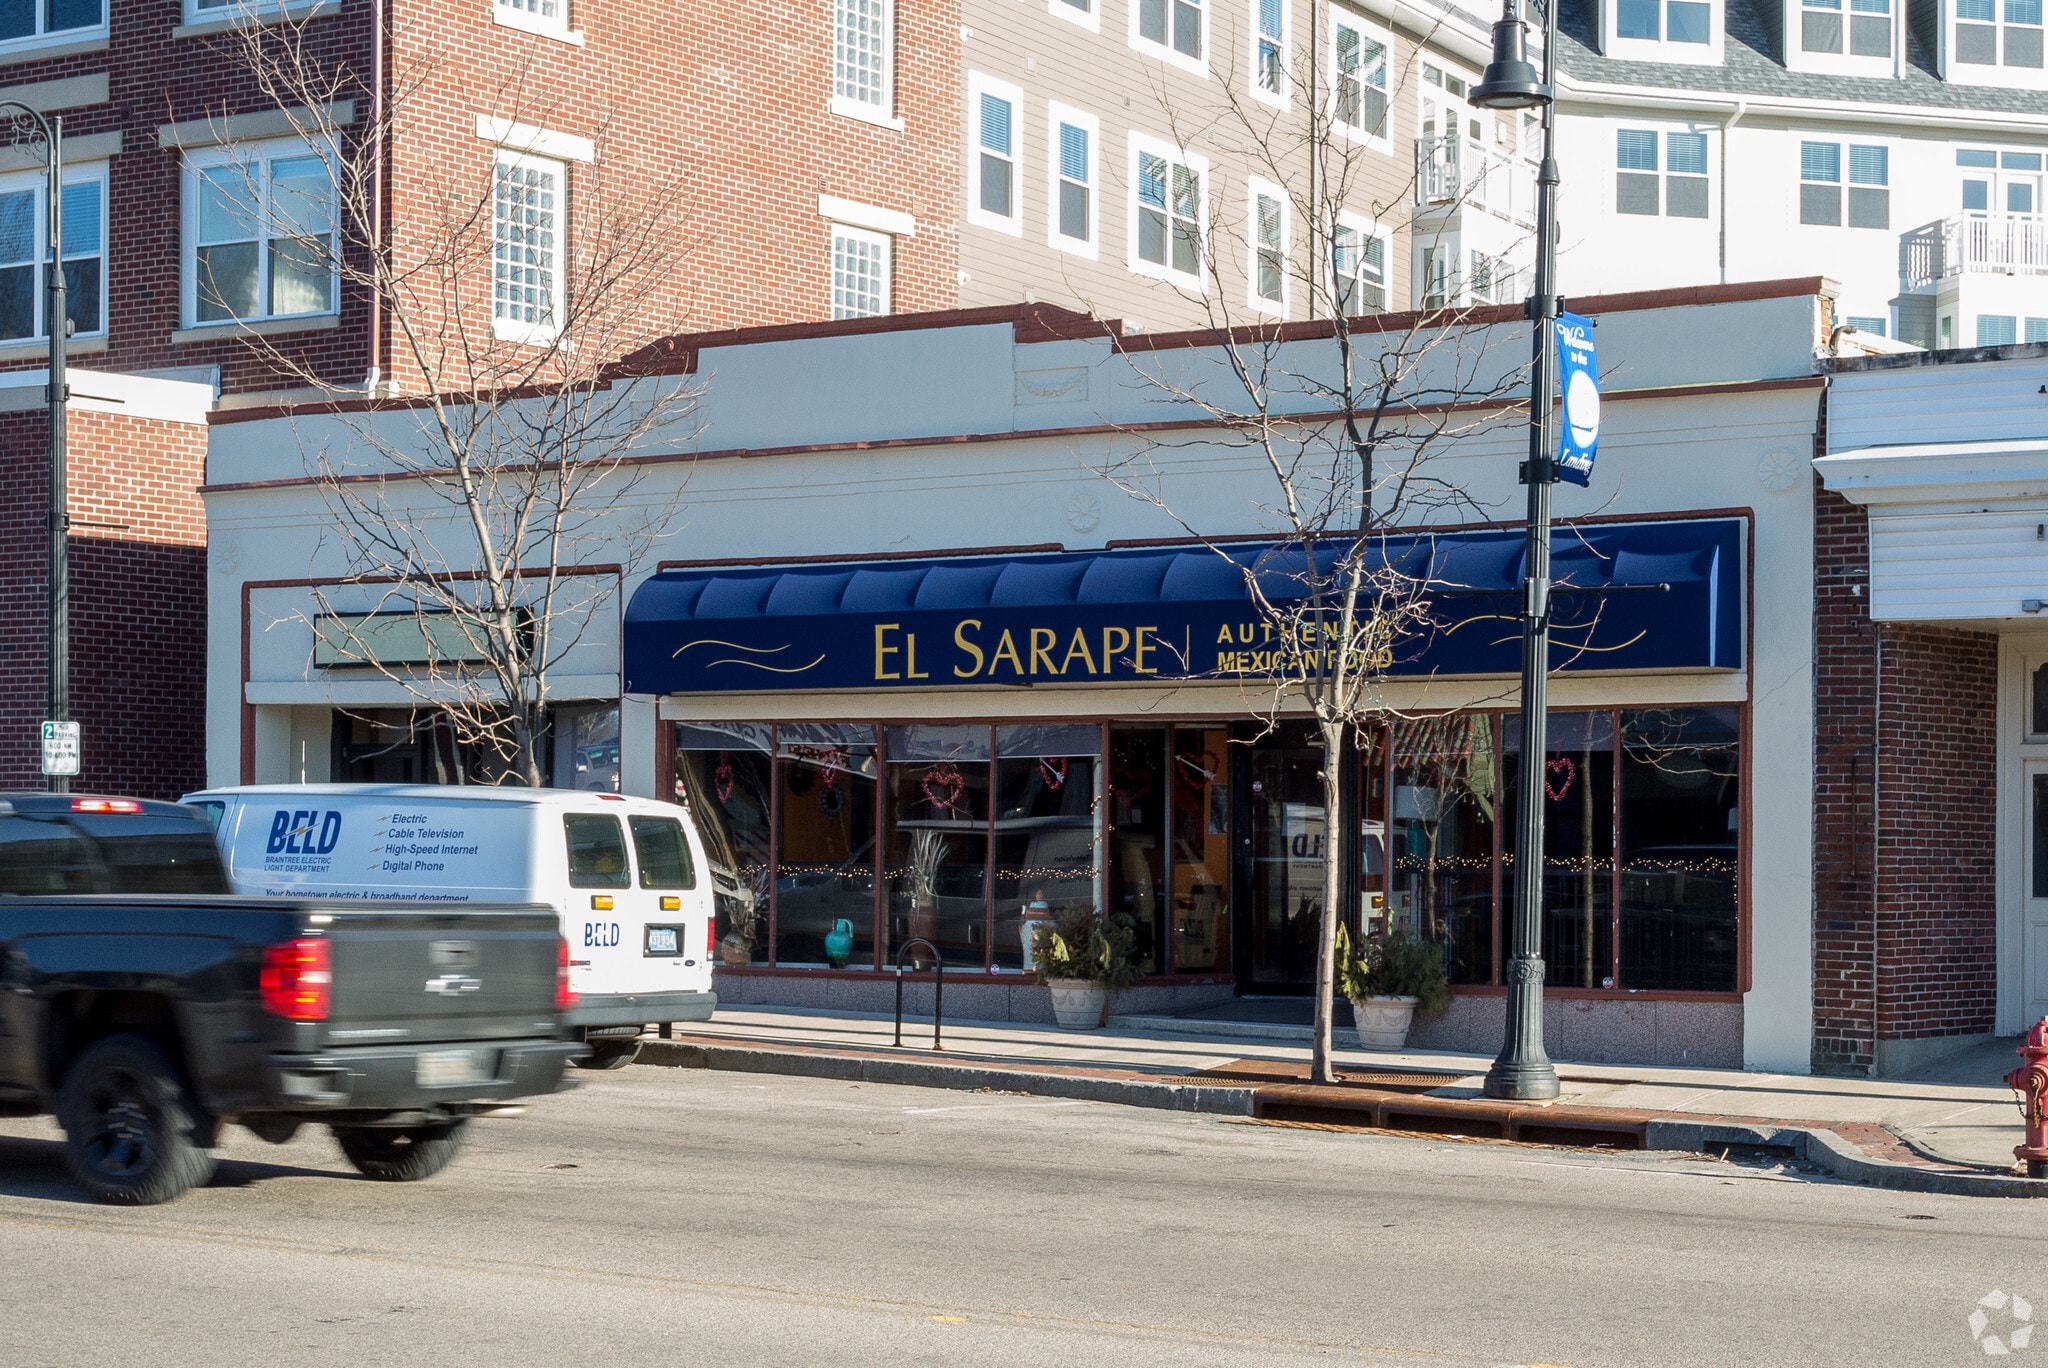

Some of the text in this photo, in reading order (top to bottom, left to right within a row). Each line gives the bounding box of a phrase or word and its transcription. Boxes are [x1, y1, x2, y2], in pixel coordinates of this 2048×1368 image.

[1556, 323, 1595, 353] Welcome
[1571, 351, 1577, 363] to
[1560, 448, 1593, 476] Landing
[874, 618, 1158, 680] EL SARAPE
[1217, 651, 1319, 671] MEXICAN
[45, 725, 53, 738] 2
[391, 813, 428, 824] Electric
[265, 810, 342, 855] BELD
[388, 828, 465, 839] Cable Television
[385, 844, 479, 856] High-Speed Internet
[265, 856, 332, 865] BRAINTREE ELECTRIC
[382, 860, 445, 873] Digital Phone
[285, 865, 330, 873] DEPARTMENT
[584, 922, 620, 947] BELD
